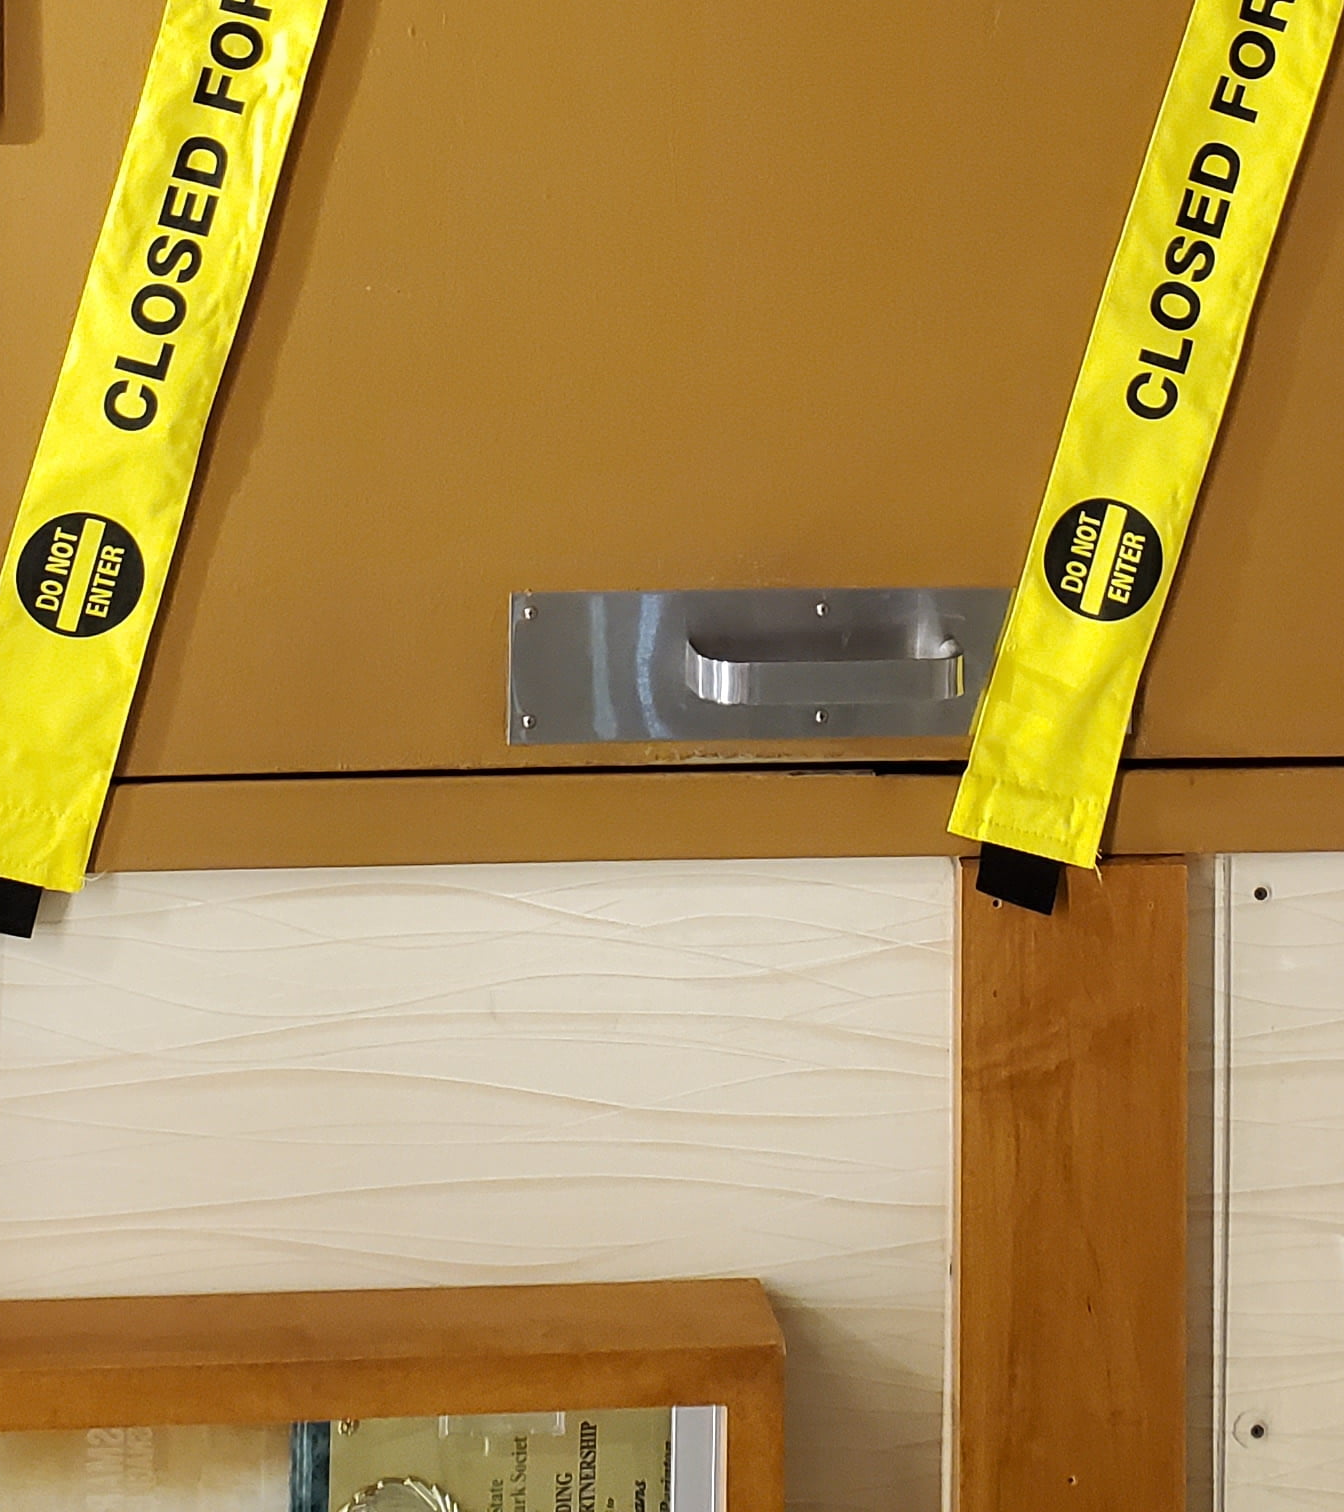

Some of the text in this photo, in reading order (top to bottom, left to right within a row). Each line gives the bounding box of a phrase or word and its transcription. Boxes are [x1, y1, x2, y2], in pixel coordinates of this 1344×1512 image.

[103, 136, 229, 432] CLOSED
[1126, 142, 1242, 421] CLOSED
[35, 526, 78, 612] DO NOT
[85, 544, 125, 619] ENTER
[1060, 510, 1102, 594] DO NOT
[1107, 531, 1146, 604] ENTER
